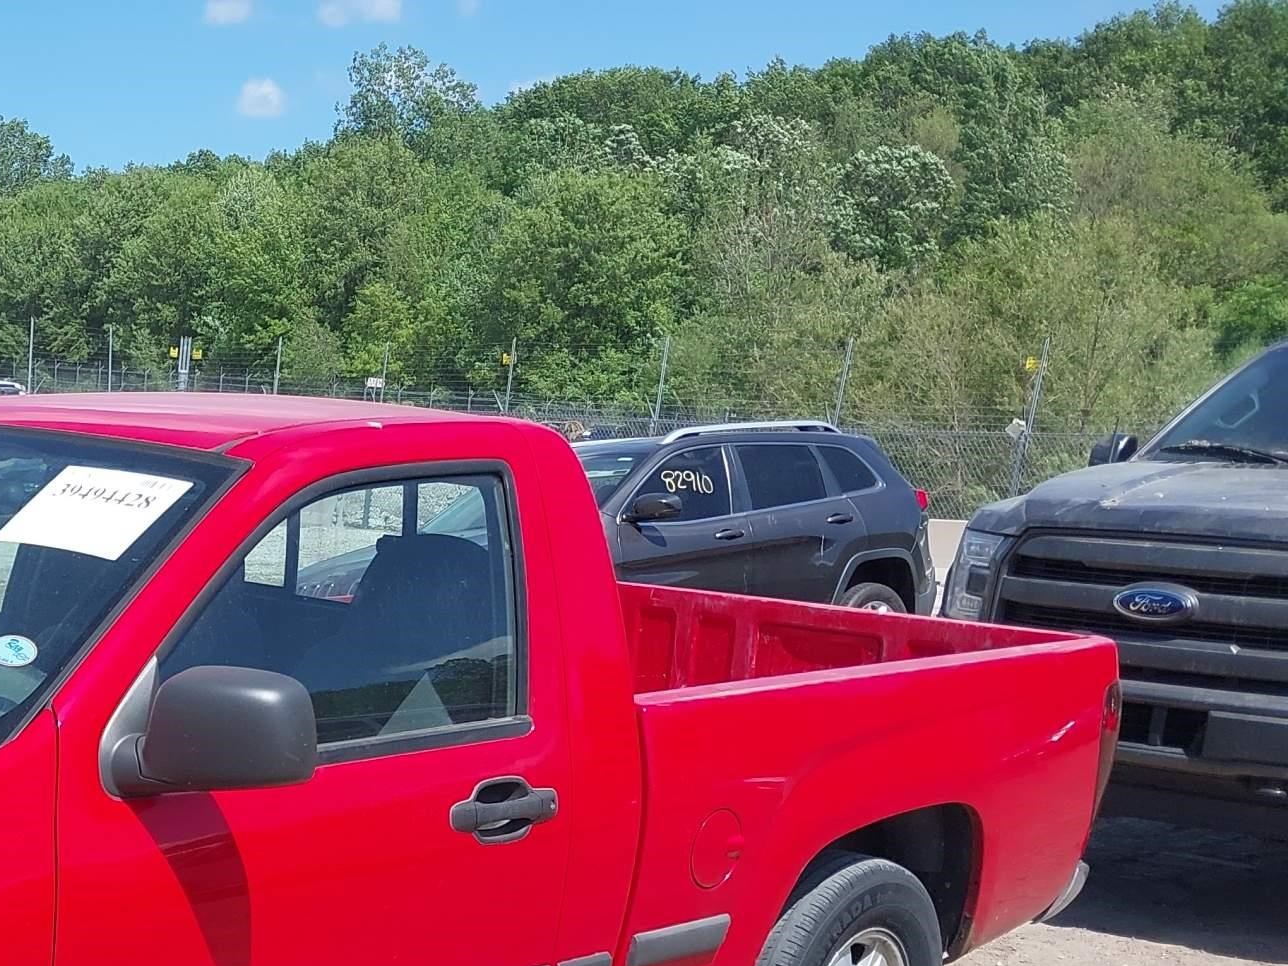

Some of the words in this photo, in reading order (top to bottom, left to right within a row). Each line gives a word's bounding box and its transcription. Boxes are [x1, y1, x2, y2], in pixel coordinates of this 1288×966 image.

[661, 470, 713, 494] 82910
[59, 483, 157, 508] 39494428
[1128, 593, 1172, 614] Ford
